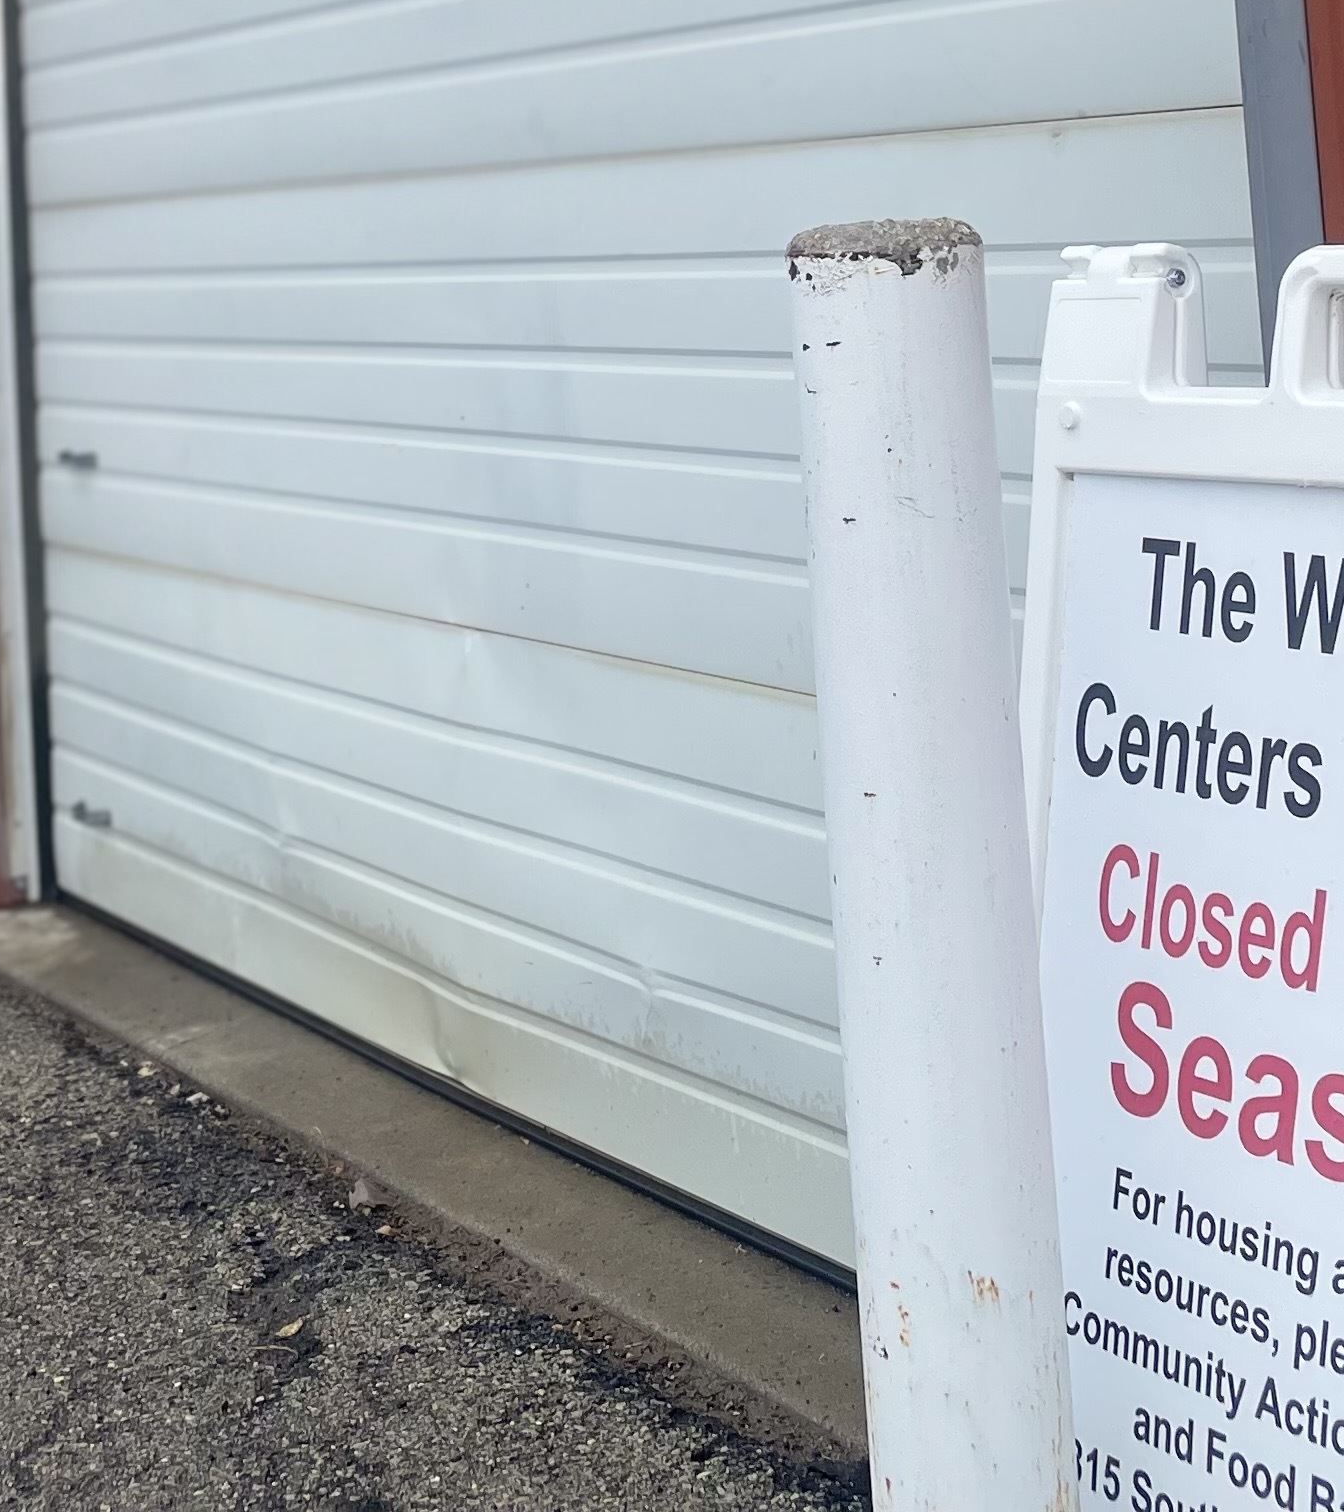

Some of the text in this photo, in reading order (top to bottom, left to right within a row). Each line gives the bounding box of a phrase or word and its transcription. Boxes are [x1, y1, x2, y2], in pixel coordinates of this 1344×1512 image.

[1142, 537, 1256, 643] The
[1075, 682, 1323, 819] Centers
[1098, 844, 1327, 993] Closed
[1112, 1167, 1166, 1225] For
[1175, 1190, 1319, 1295] housing
[1064, 1291, 1247, 1420] Community
[1104, 1245, 1280, 1358] resources,
[1132, 1407, 1195, 1466] and
[1206, 1427, 1296, 1512] Food
